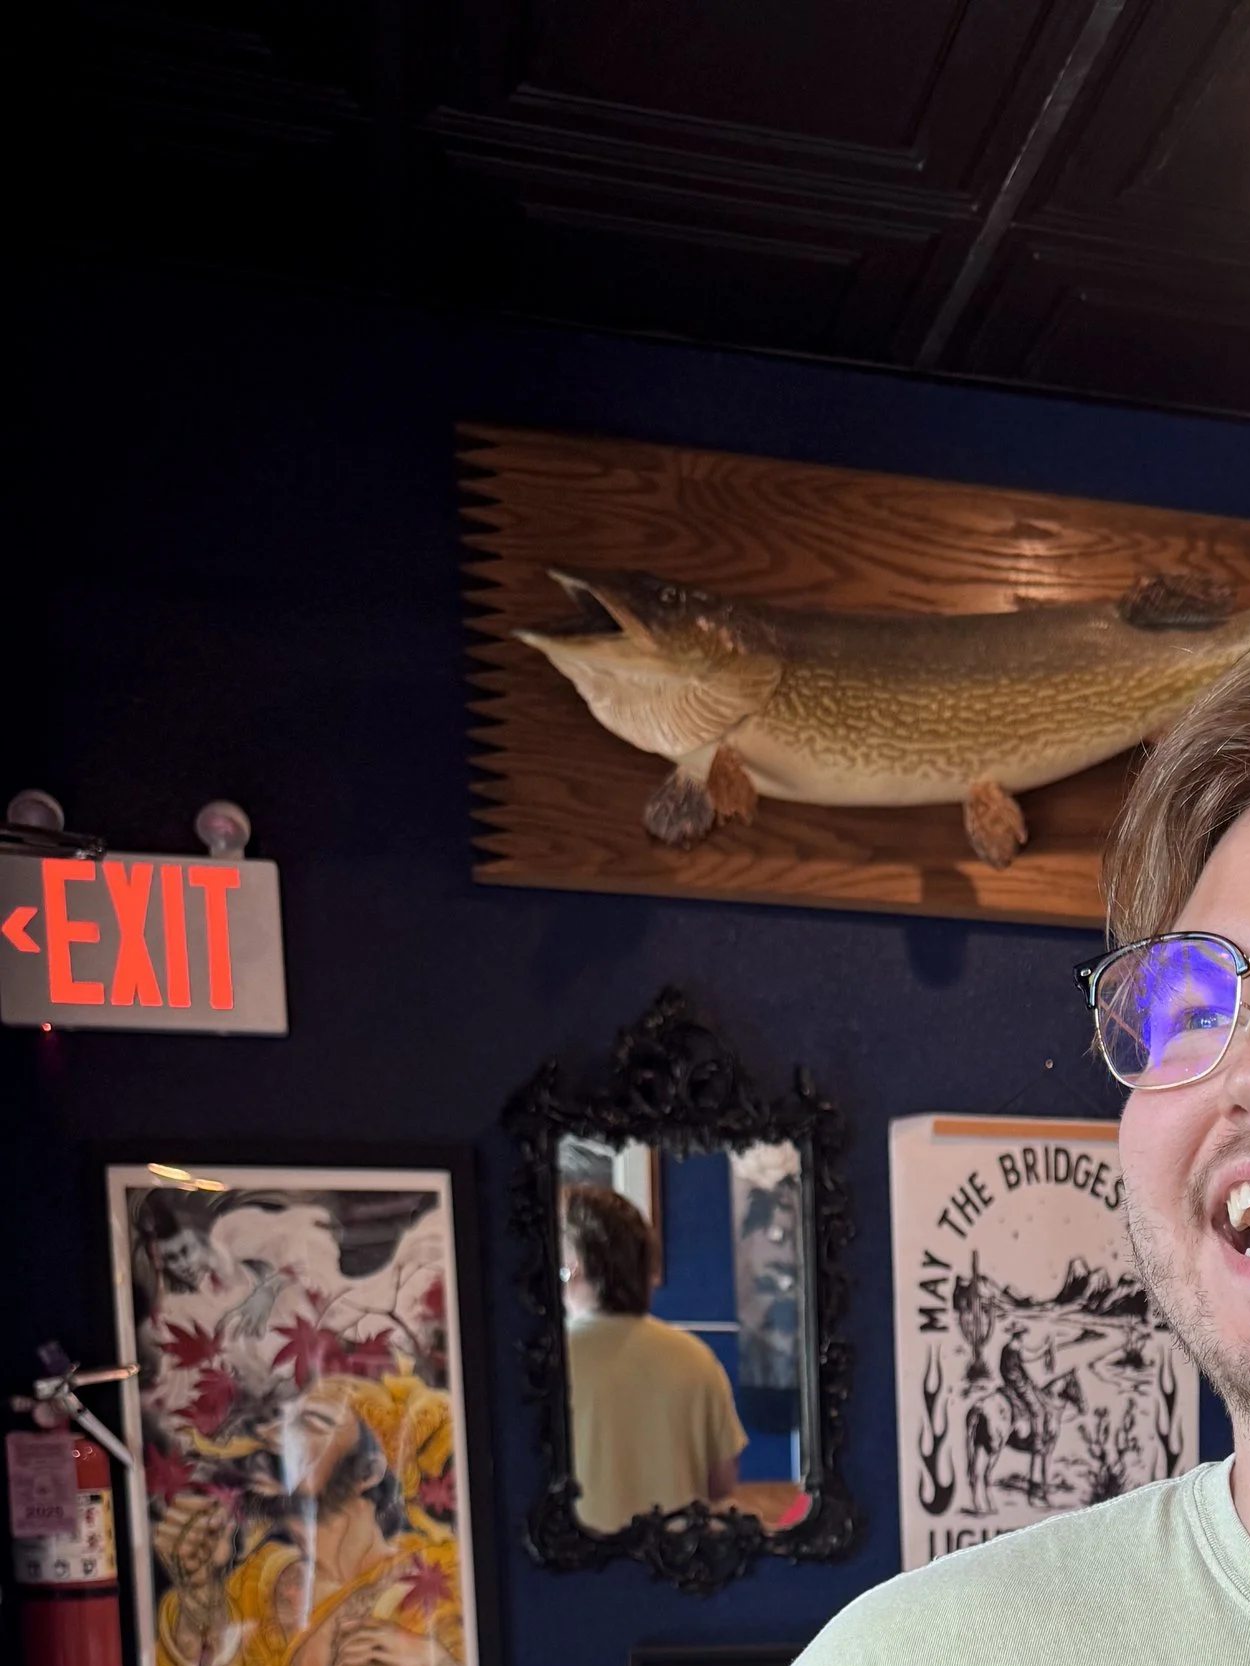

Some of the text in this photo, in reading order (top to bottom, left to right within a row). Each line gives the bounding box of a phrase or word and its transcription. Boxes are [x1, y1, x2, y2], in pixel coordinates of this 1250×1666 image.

[42, 858, 241, 1010] EXIT
[919, 1144, 1126, 1333] MAY THE BRIDGES
